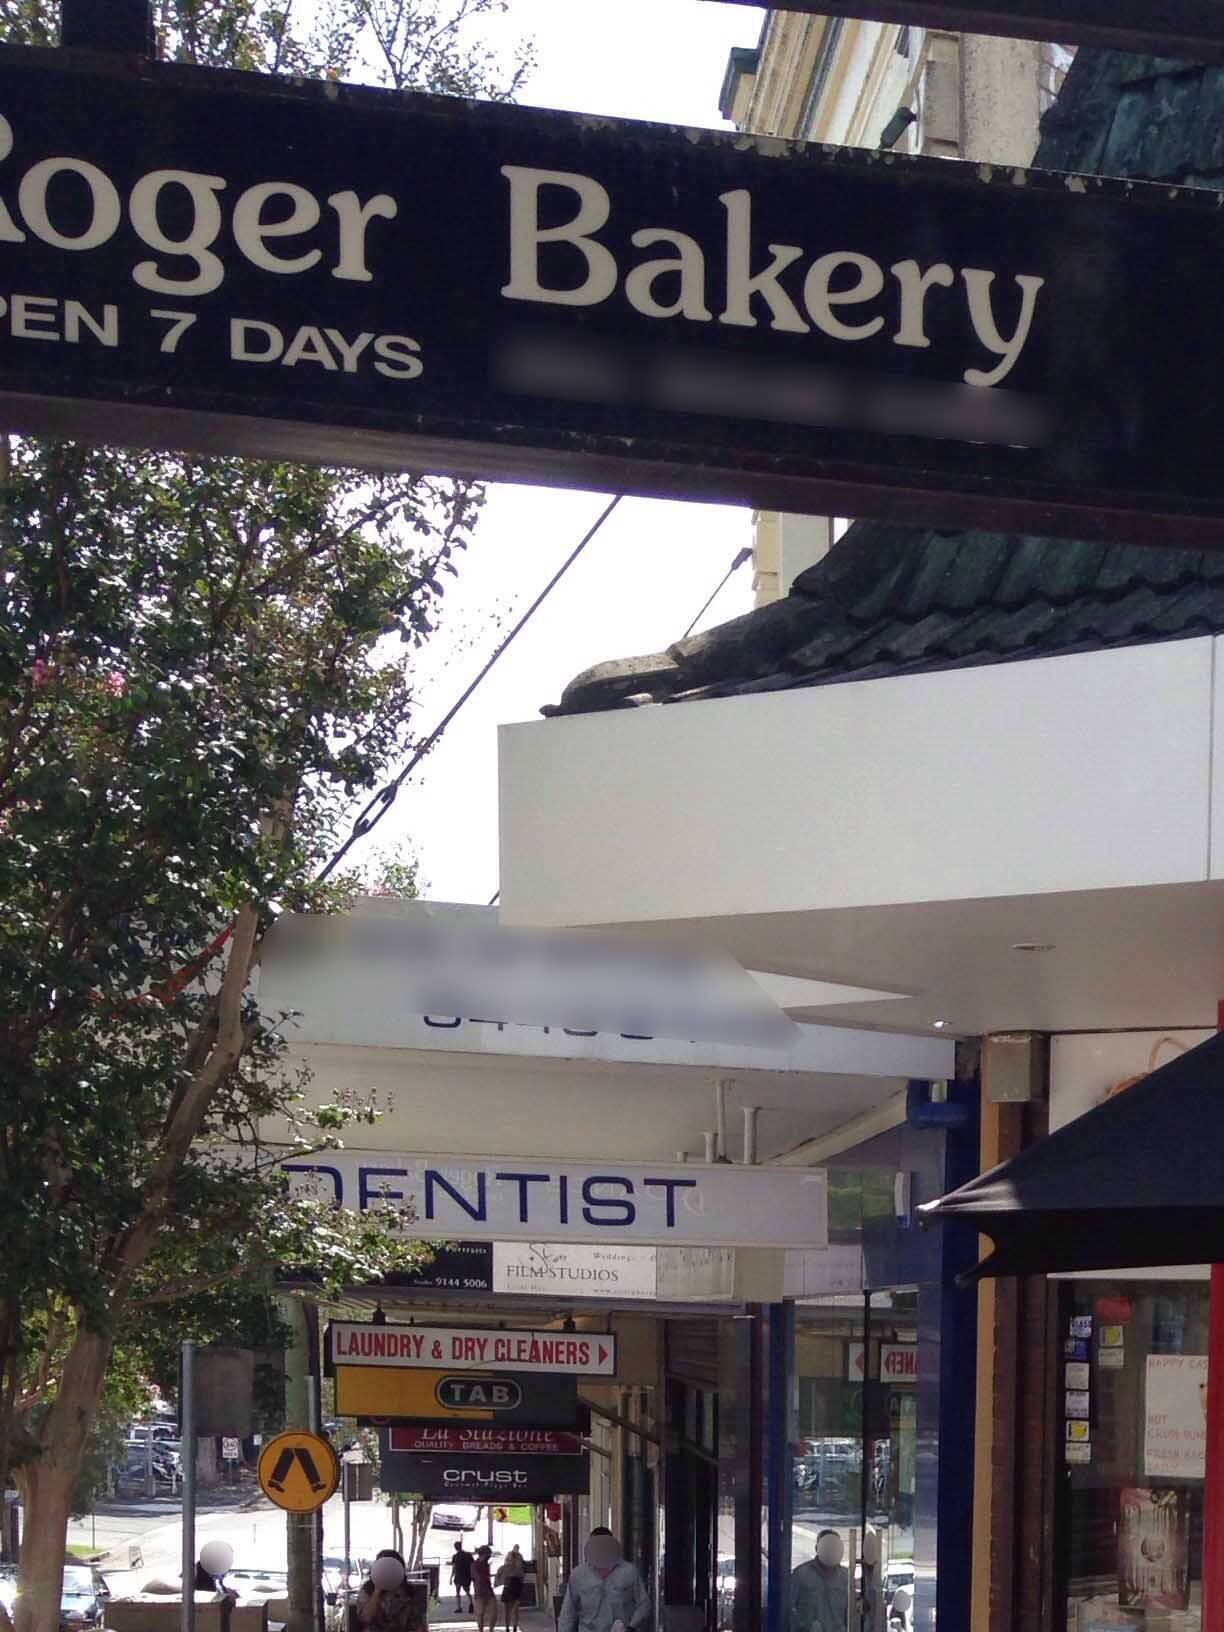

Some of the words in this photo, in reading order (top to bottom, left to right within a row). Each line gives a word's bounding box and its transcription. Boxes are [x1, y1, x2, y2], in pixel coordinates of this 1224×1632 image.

[499, 164, 1045, 387] Bakery
[0, 292, 119, 347] EN
[150, 308, 197, 353] 7
[230, 317, 425, 380] DAYS
[506, 1264, 544, 1279] FILM
[549, 1266, 619, 1282] STUDIOS
[435, 1277, 460, 1288] 9144
[463, 1278, 488, 1289] 5006
[337, 1331, 424, 1360] LAUNDRY
[432, 1339, 443, 1360] &
[452, 1336, 488, 1361] DRY
[494, 1338, 590, 1366] CLEANERS
[450, 1383, 511, 1402] TAB
[414, 1440, 454, 1450] QUALITY
[462, 1441, 503, 1451] BREADS
[520, 1442, 559, 1452] COFFEE
[443, 1469, 528, 1484] crust
